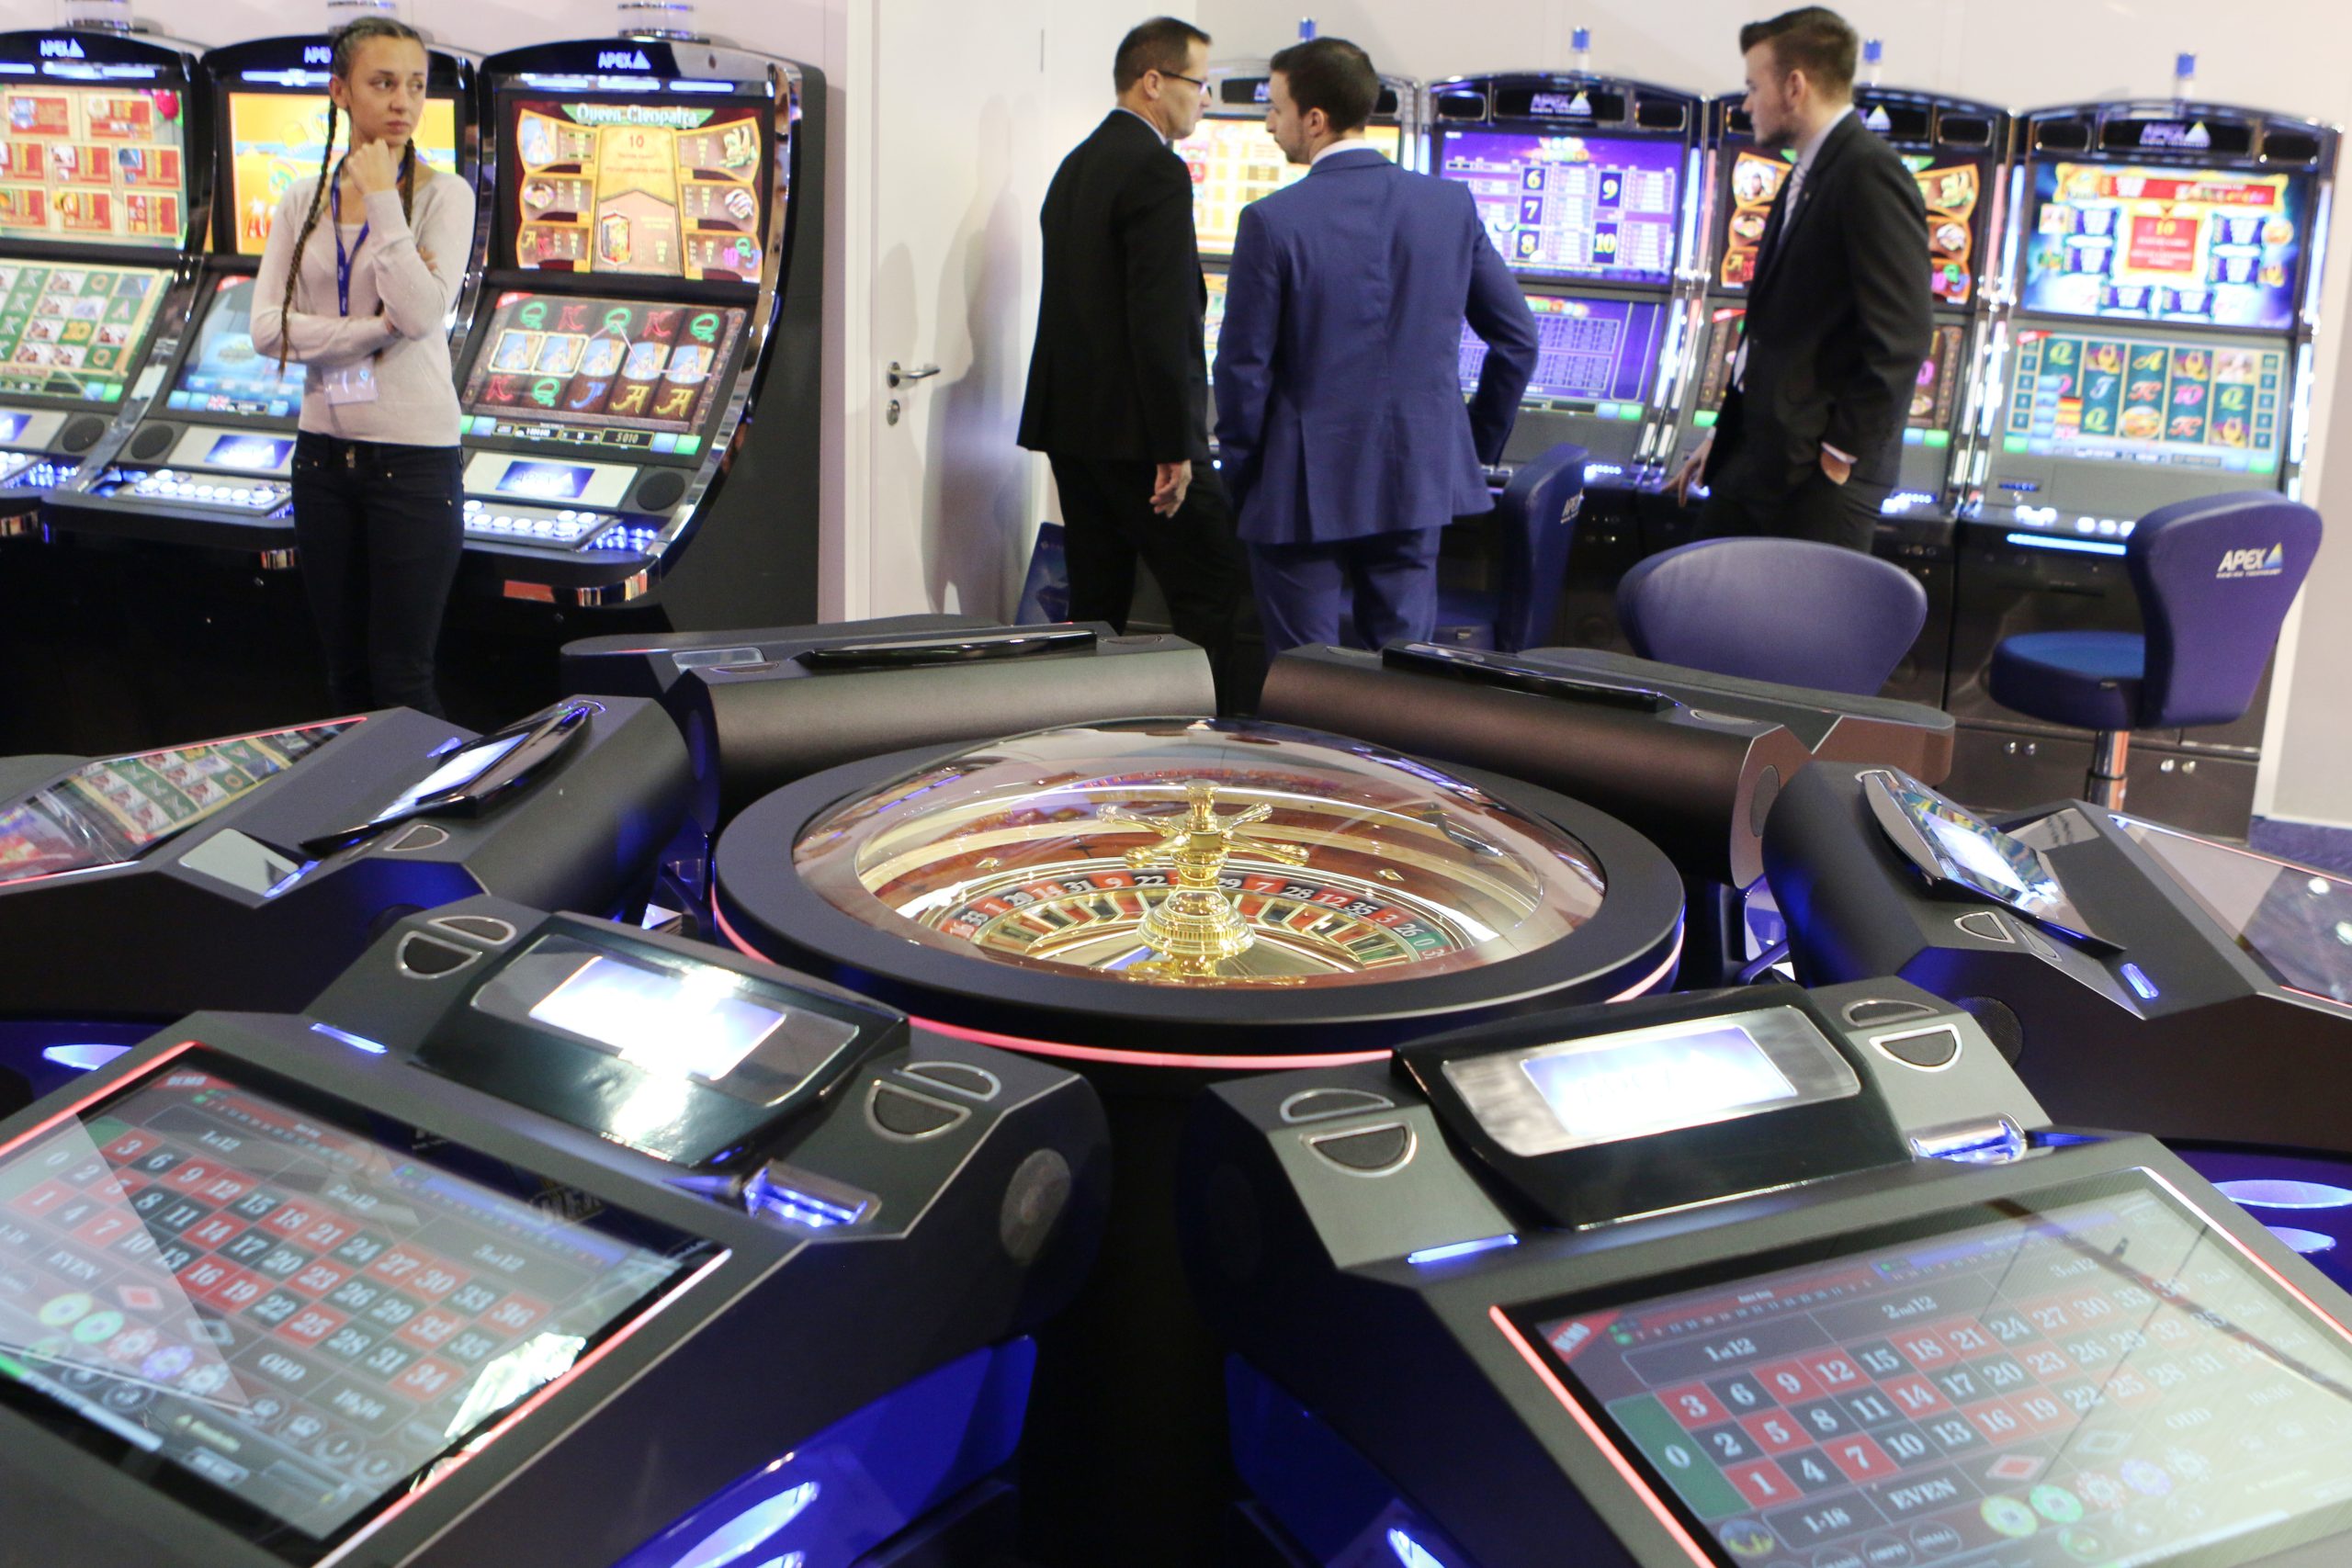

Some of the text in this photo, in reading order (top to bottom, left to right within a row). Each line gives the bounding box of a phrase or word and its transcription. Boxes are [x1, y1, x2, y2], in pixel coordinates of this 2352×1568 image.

[304, 46, 332, 63] APE
[598, 51, 633, 69] APEX
[577, 103, 697, 129] Queen Cleopatra
[629, 135, 645, 148] 10
[1527, 170, 1618, 199] 6 9
[1525, 200, 1539, 220] 7
[519, 301, 548, 331] Q
[690, 313, 719, 343] Q
[531, 378, 560, 407] Q
[2217, 547, 2267, 571] APEX
[1063, 879, 1098, 892] 31
[1104, 877, 1124, 889] 9
[1134, 875, 1168, 887] 22
[1254, 882, 1273, 893] 7
[1283, 886, 1314, 900] 28
[1317, 893, 1347, 908] 12
[1345, 901, 1379, 917] 35
[1379, 913, 1397, 924] 3
[1393, 922, 1424, 938] 26
[1414, 938, 1434, 947] 0
[46, 1151, 71, 1166] 0
[72, 1165, 100, 1181] 2
[136, 1192, 164, 1210] 8
[164, 1206, 199, 1227] 11
[196, 1221, 232, 1243] 14
[229, 1235, 268, 1258] 17
[262, 1250, 304, 1274] 20
[297, 1266, 340, 1291] 23
[117, 1139, 143, 1156] 3
[146, 1153, 175, 1168] 6
[178, 1167, 205, 1182] 9
[206, 1179, 242, 1200] 12
[238, 1194, 277, 1215] 15
[272, 1208, 310, 1230] 18
[306, 1223, 345, 1246] 21
[339, 1236, 385, 1262] 24
[376, 1251, 421, 1277] 27
[415, 1270, 458, 1295] 30
[31, 1190, 57, 1207] 1
[62, 1204, 89, 1222] 4
[94, 1219, 122, 1235] 7
[121, 1233, 156, 1254] 10
[154, 1247, 191, 1269] 13
[185, 1262, 225, 1286] 16
[220, 1279, 260, 1303] 19
[254, 1294, 298, 1321] 22
[289, 1311, 335, 1337] 25
[1679, 1394, 1708, 1417] 3
[1730, 1382, 1756, 1405] 6
[1776, 1372, 1802, 1394] 9
[1815, 1359, 1855, 1384] 12
[1861, 1348, 1900, 1372] 15
[1905, 1338, 1944, 1361] 18
[1950, 1326, 1987, 1350] 21
[1990, 1316, 2031, 1340] 24
[2032, 1305, 2067, 1329] 27
[2073, 1296, 2112, 1319] 30
[2112, 1286, 2153, 1309] 33
[1713, 1432, 1743, 1457] 2
[1763, 1420, 1790, 1444] 5
[1810, 1408, 1838, 1432] 8
[1850, 1395, 1892, 1421] 11
[1896, 1383, 1936, 1409] 14
[1941, 1372, 1975, 1397] 17
[1983, 1360, 2022, 1386] 20
[2026, 1349, 2067, 1375] 23
[2068, 1339, 2108, 1363] 26
[2109, 1328, 2148, 1353] 29
[1664, 1444, 1691, 1469] 0
[1749, 1471, 1778, 1495] 1
[1800, 1458, 1828, 1483] 4
[1844, 1445, 1871, 1470] 7
[1886, 1431, 1926, 1459] 10
[1933, 1420, 1973, 1447] 13
[1977, 1407, 2017, 1434] 16
[2022, 1396, 2060, 1422] 19
[2064, 1383, 2106, 1412] 22
[2108, 1372, 2146, 1397] 25
[1804, 1507, 1852, 1534] 1-18
[1887, 1476, 1958, 1511] EVEN
